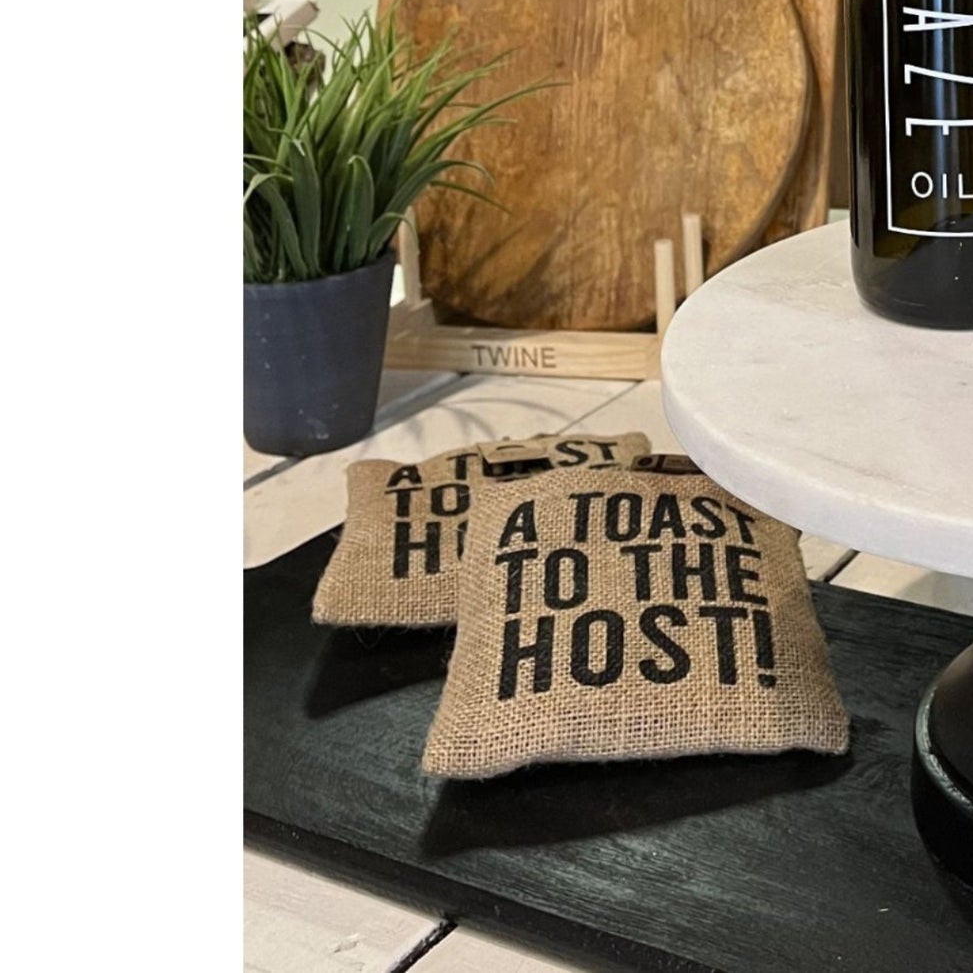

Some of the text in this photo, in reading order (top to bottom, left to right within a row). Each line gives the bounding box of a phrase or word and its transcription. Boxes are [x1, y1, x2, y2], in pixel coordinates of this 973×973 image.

[470, 344, 557, 369] TWINE
[387, 463, 423, 488] A
[384, 483, 470, 518] TO
[498, 491, 756, 548] A TOAST
[495, 543, 768, 615] TO THE
[497, 604, 778, 701] HOST!
